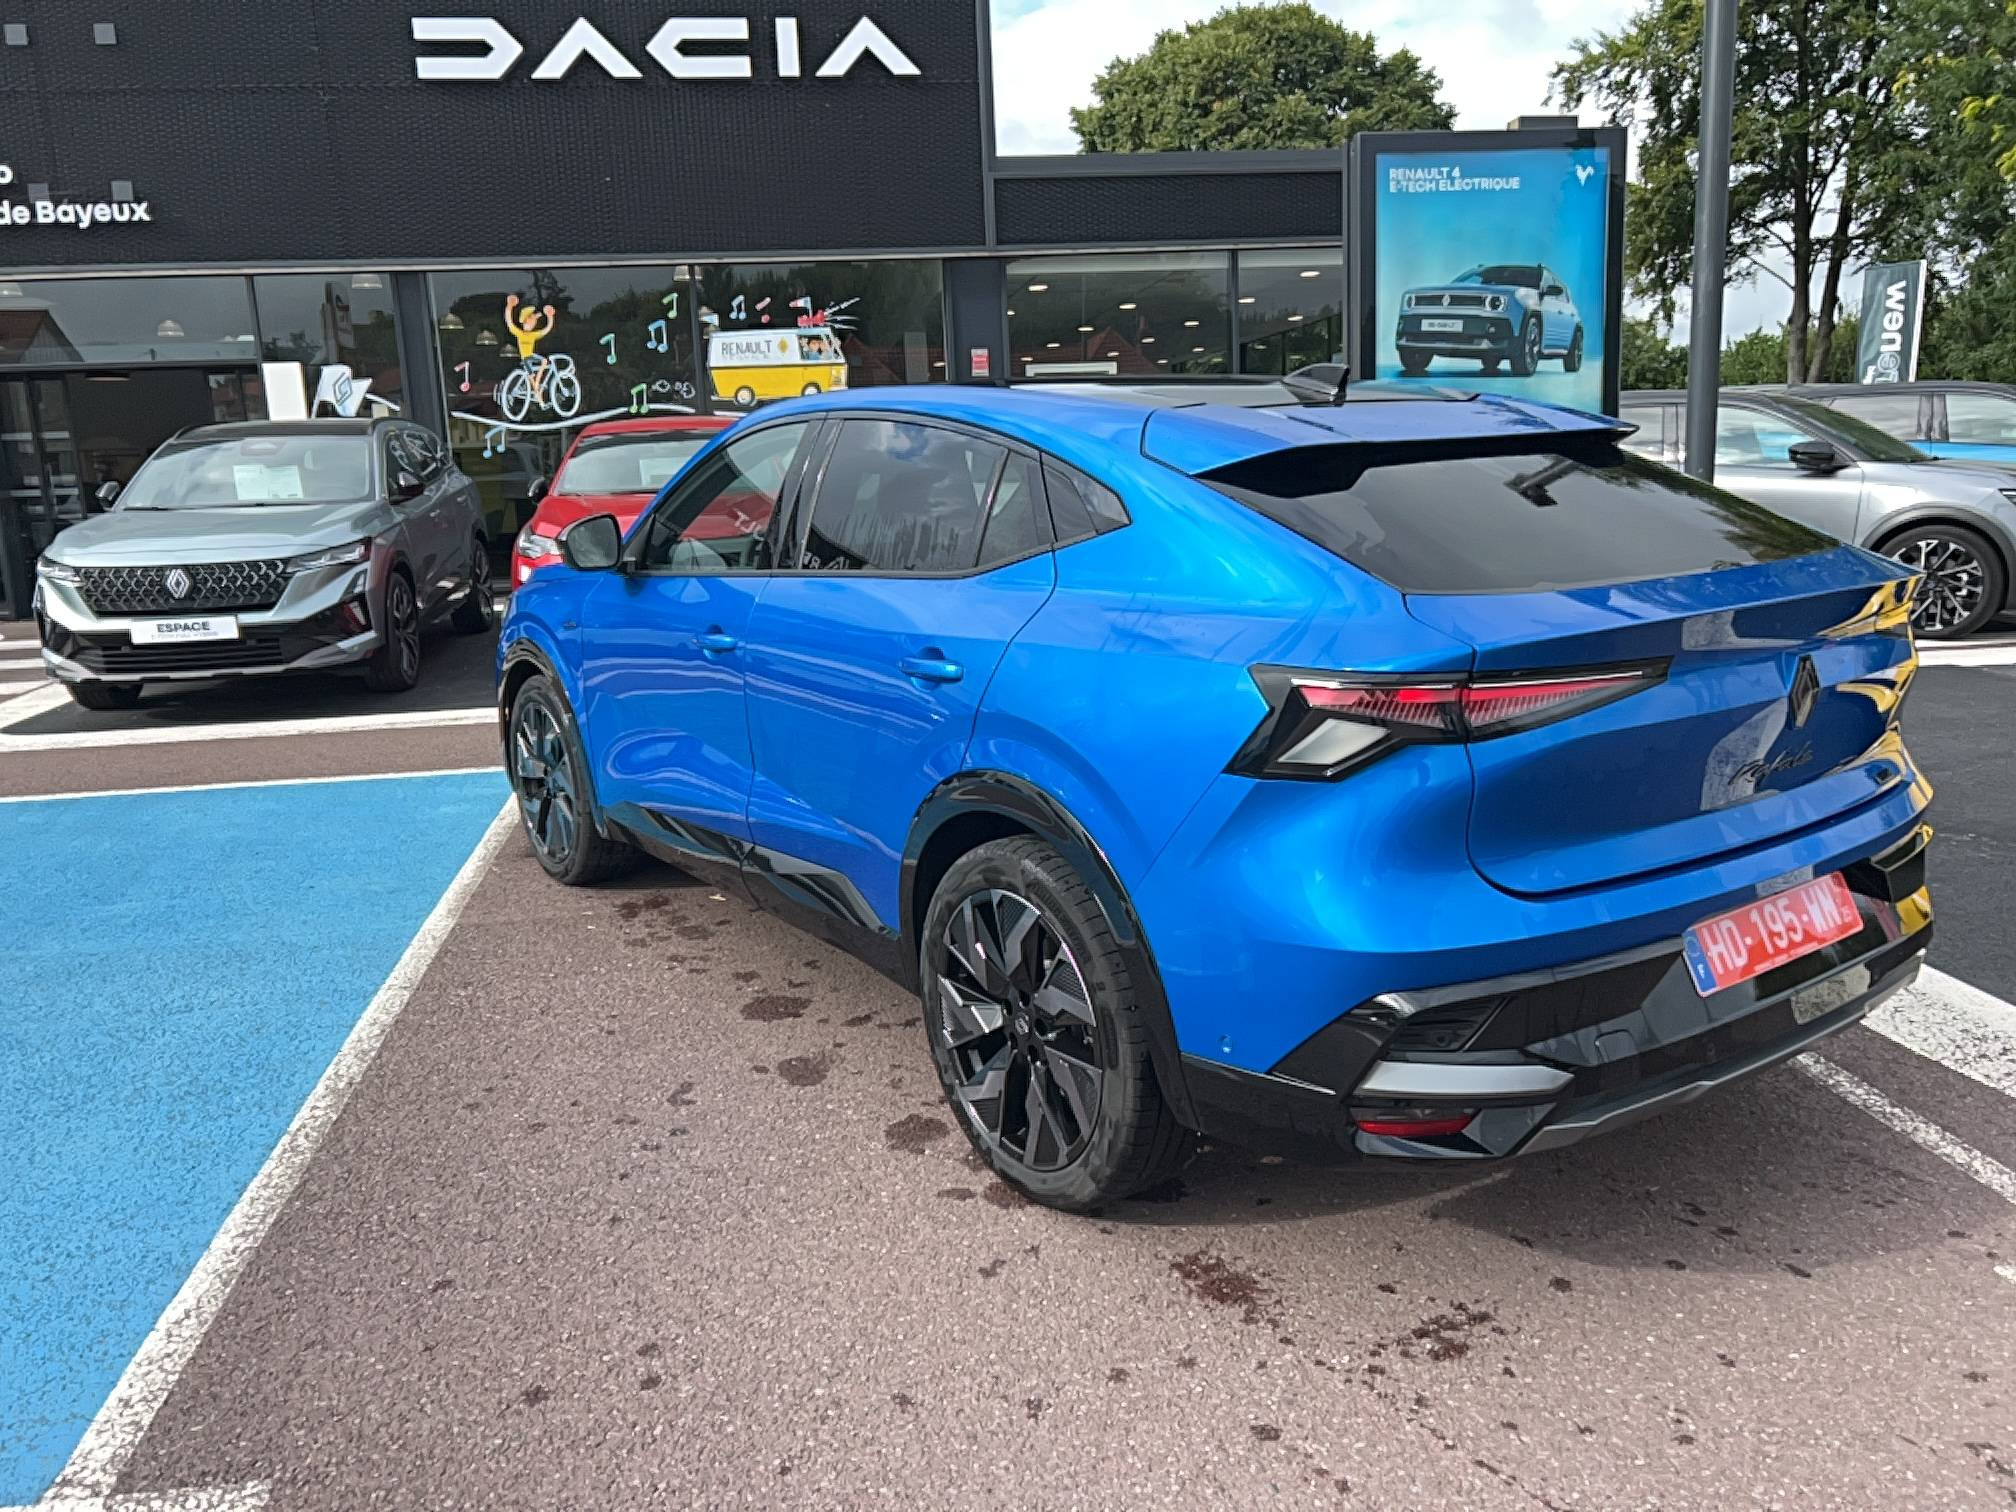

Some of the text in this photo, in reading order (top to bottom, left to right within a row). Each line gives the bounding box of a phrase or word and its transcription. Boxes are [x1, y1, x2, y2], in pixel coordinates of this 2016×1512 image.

[409, 16, 922, 80] DACIA
[1389, 166, 1461, 180] RENAULT 4
[34, 200, 152, 229] Bayeux
[721, 339, 773, 358] RENAULT
[156, 621, 211, 633] ESPACE
